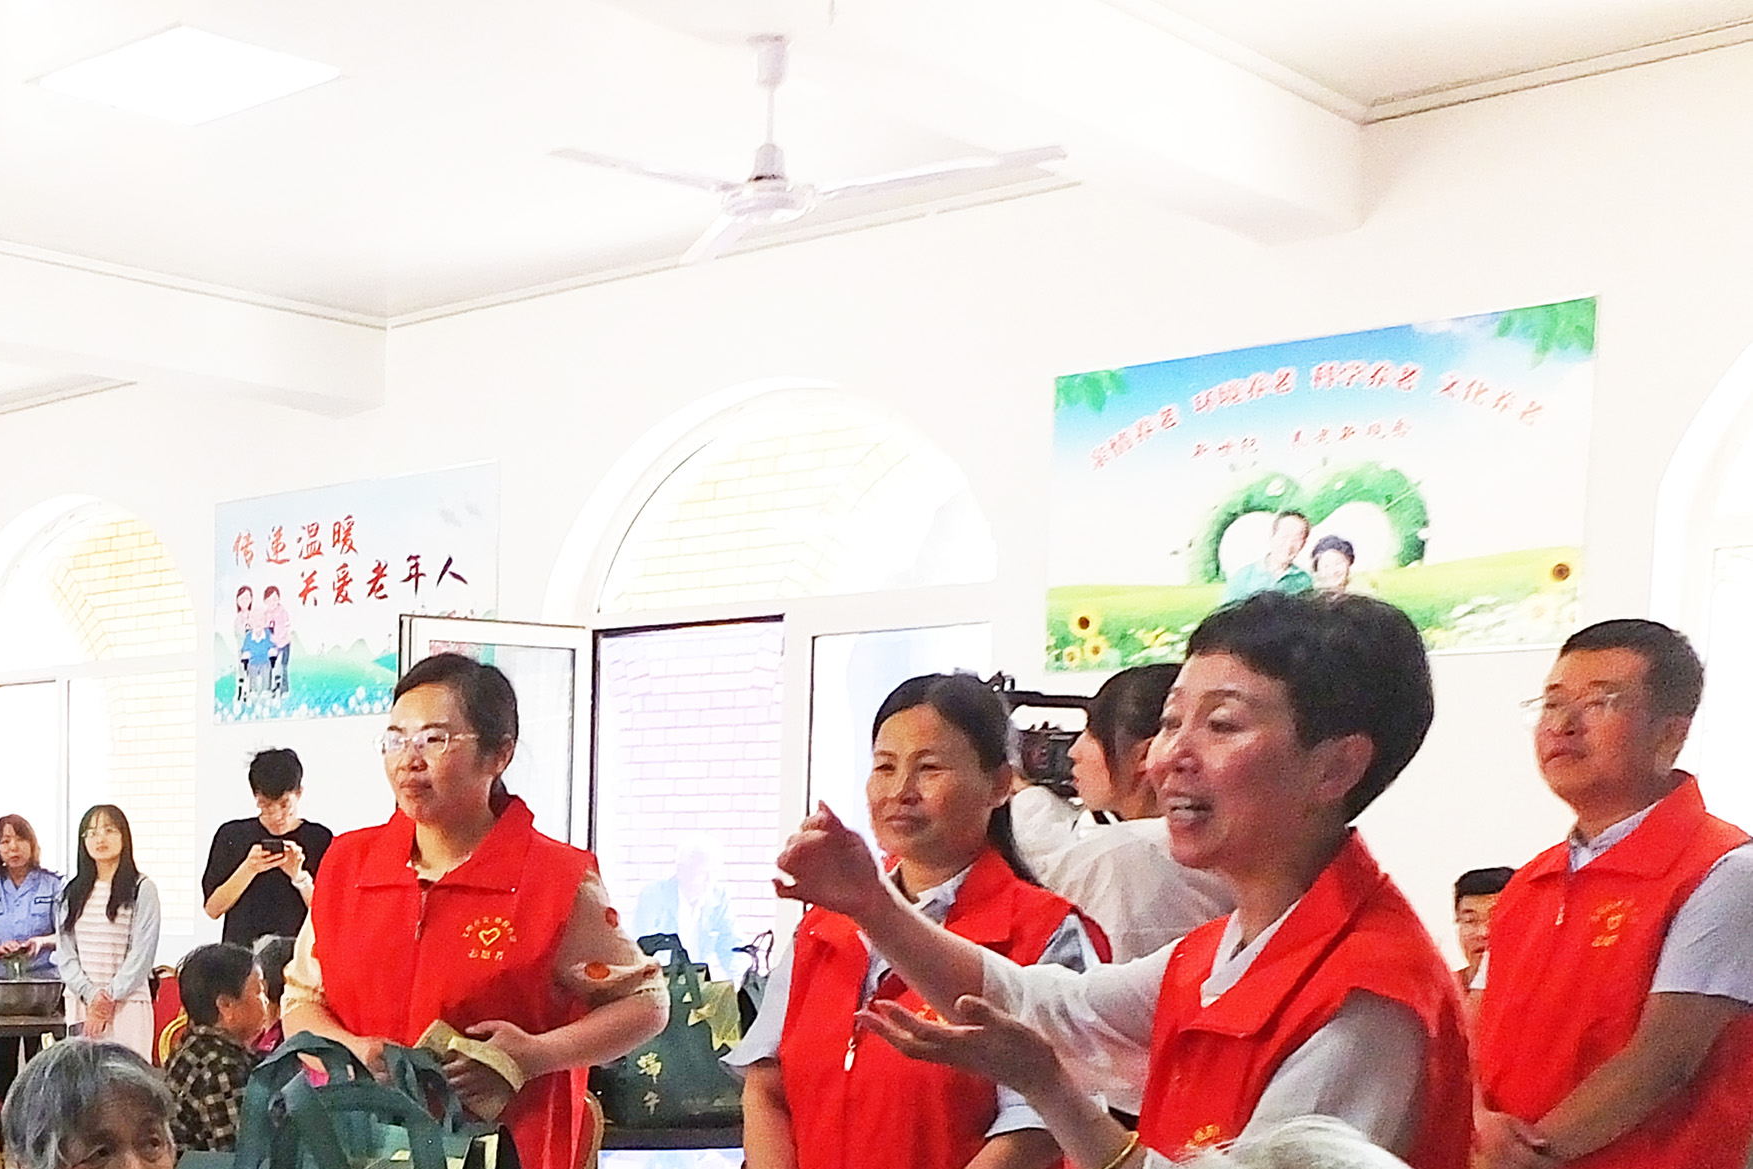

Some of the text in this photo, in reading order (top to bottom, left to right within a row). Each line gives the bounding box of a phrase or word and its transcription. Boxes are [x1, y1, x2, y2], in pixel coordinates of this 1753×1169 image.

[233, 513, 358, 569] 传递温暖
[298, 553, 468, 606] 关爱老年人
